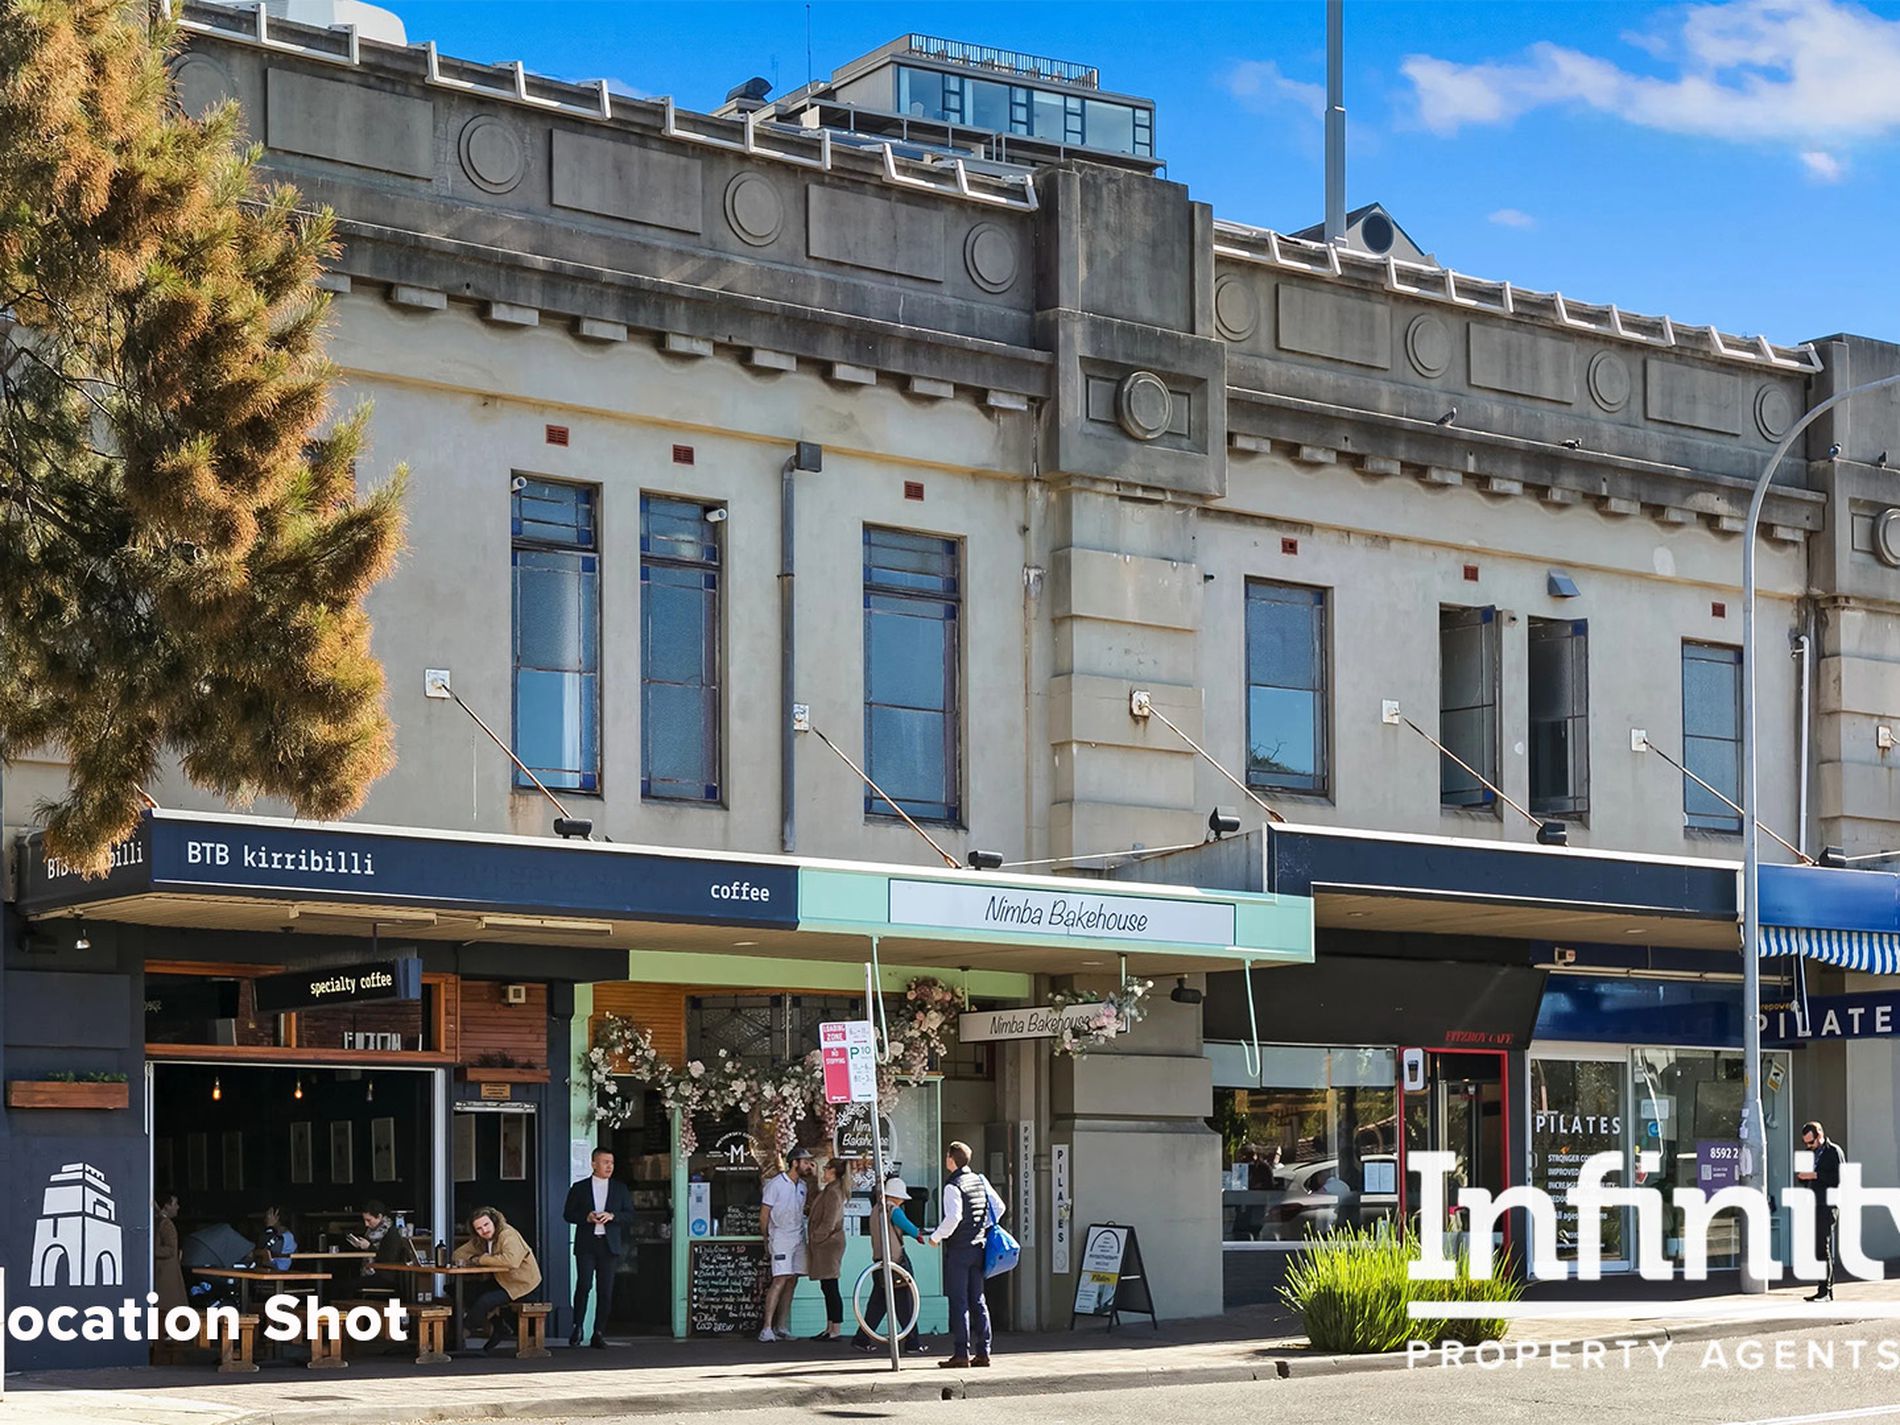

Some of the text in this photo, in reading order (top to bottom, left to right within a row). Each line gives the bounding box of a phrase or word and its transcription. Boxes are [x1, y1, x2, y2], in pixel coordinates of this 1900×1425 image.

[187, 841, 375, 875] BTB kirribilli
[710, 881, 770, 902] coffee
[985, 896, 1148, 932] Nimba Bakehouse
[310, 971, 393, 998] specialty coffee
[990, 1016, 1025, 1035] Nimba
[849, 1046, 871, 1060] P 10
[1536, 1114, 1621, 1135] PILATES
[1710, 1147, 1732, 1159] 8592
[1022, 1126, 1030, 1241] PHYSIOTHERAPY
